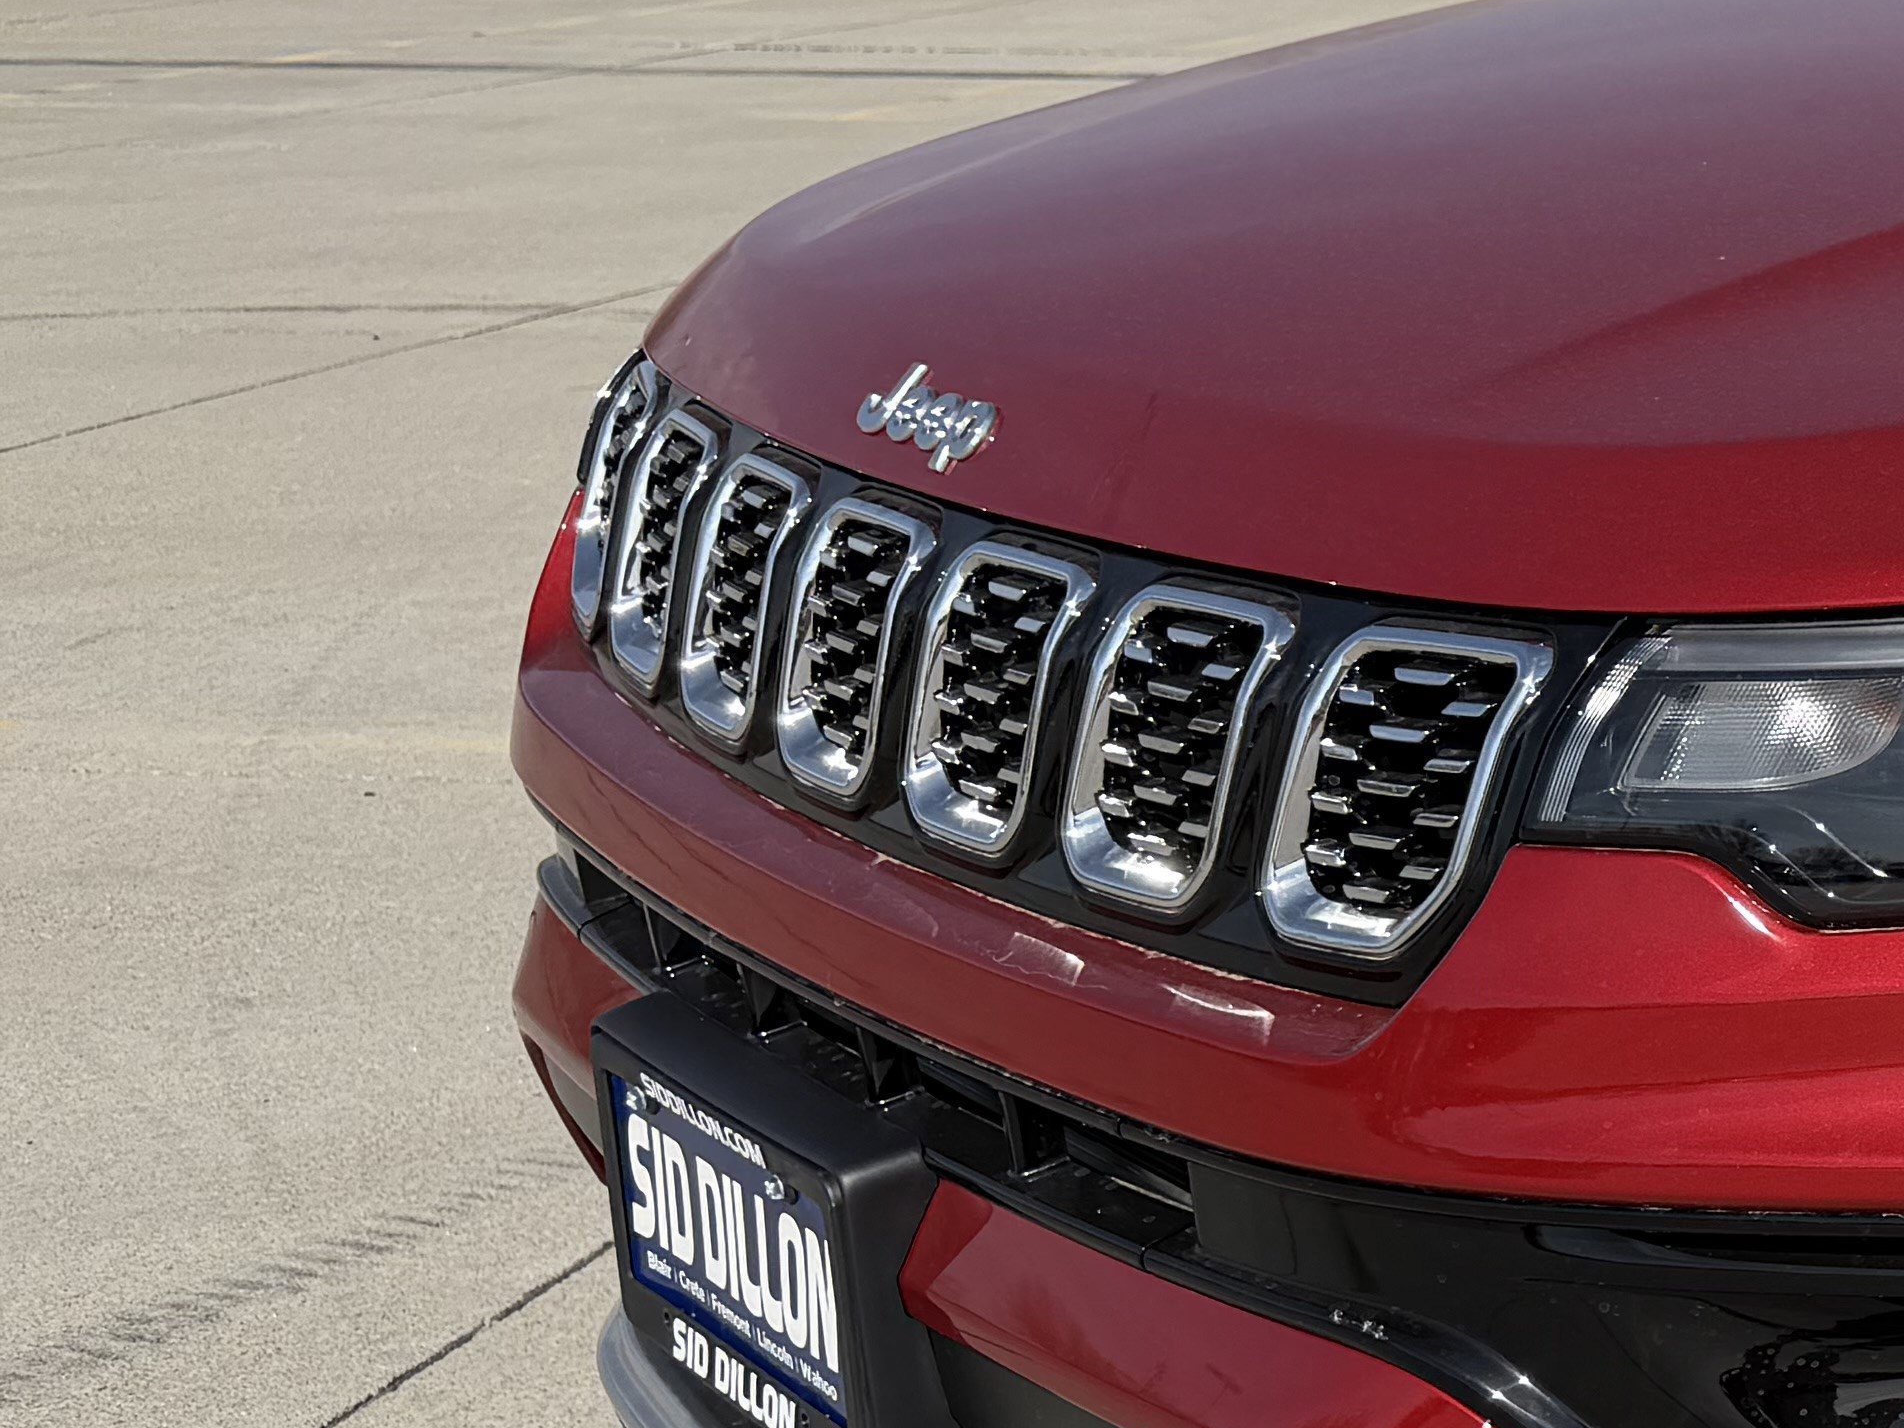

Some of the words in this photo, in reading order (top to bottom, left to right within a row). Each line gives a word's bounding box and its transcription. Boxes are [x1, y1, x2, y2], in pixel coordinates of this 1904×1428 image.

[857, 362, 997, 473] Jeep
[640, 1072, 766, 1169] SIDDILLON.COM
[627, 1113, 695, 1266] SID
[696, 1155, 839, 1373] DILLON
[647, 1250, 672, 1279] Blair
[679, 1270, 706, 1303] Crete
[711, 1293, 751, 1338] Fremont
[757, 1327, 793, 1370] Lincoln
[800, 1359, 837, 1401] Wahoo
[672, 1317, 709, 1379] SID
